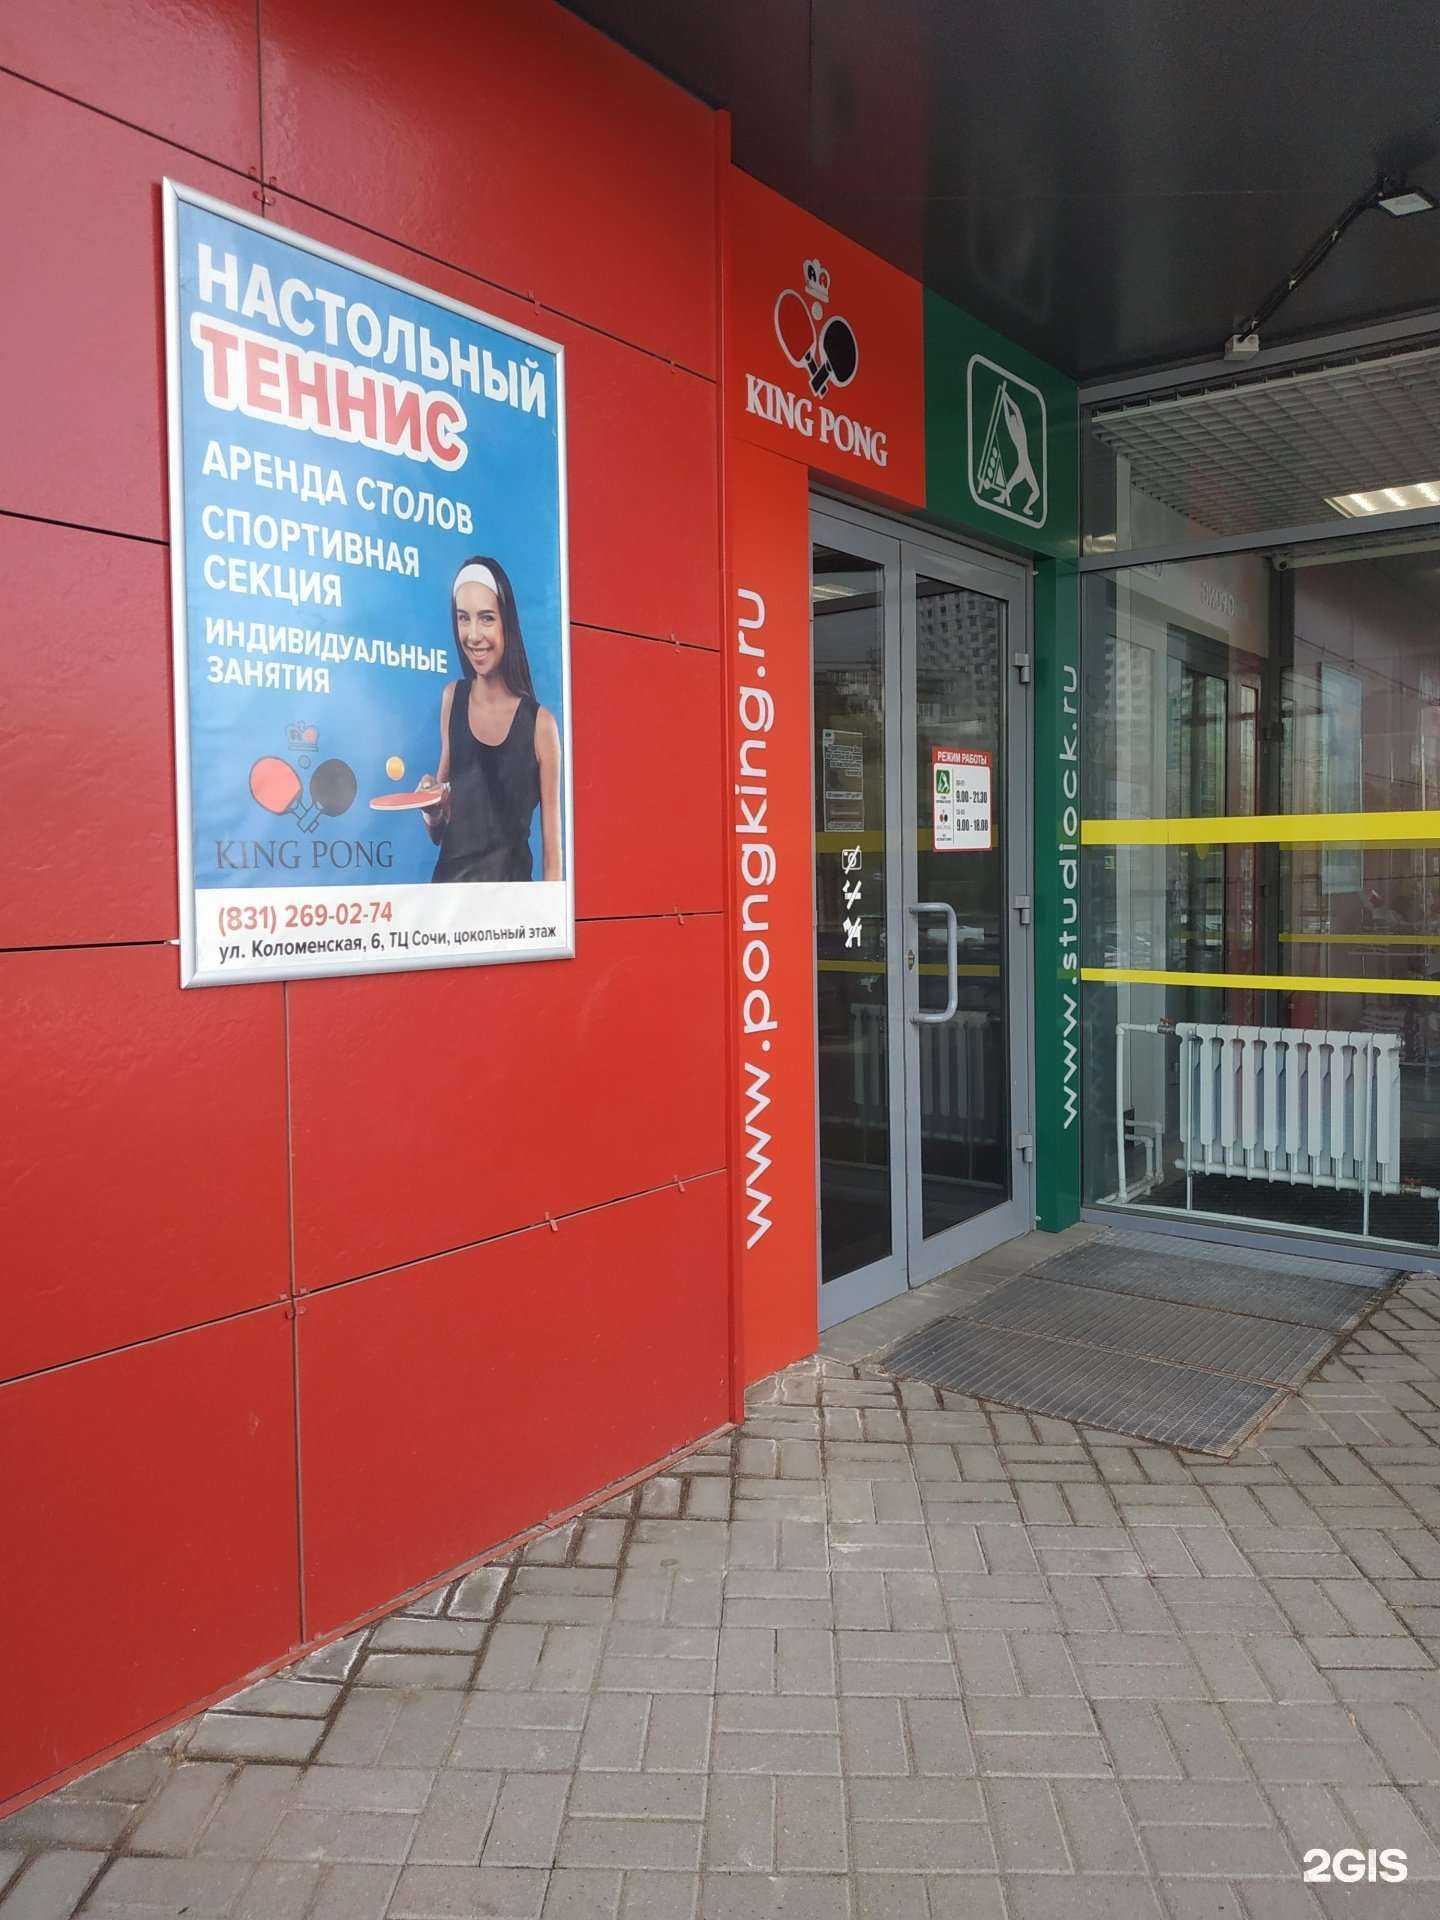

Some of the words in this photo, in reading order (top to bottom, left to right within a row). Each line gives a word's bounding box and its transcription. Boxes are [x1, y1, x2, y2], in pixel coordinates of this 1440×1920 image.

[197, 242, 547, 418] НАСТОЛЬНЫЙ
[196, 319, 464, 467] ТЕННИС
[745, 373, 814, 438] KING
[819, 406, 889, 468] PONG
[202, 440, 348, 506] АРЕНДА
[356, 476, 474, 535] СТОЛОВ
[202, 504, 420, 578] СПОРТИВНАЯ
[203, 554, 343, 608] СЕКЦИЯ
[205, 616, 449, 674] ИНДИВИДУАЛЬНЫЕ
[206, 655, 332, 694] ЗАНЯТИЯ
[937, 751, 961, 763] РЕЖИМ
[961, 753, 987, 765] РАБОТЫ
[215, 840, 301, 869] KING
[311, 840, 394, 868] PONG
[218, 906, 277, 936] (831)
[285, 901, 393, 928] 269-02-74
[735, 588, 778, 1249] www.pongking.ru
[1058, 664, 1078, 1129] www.studiock.ru
[219, 944, 246, 965] ул.
[252, 937, 367, 958] Коломенская,
[371, 932, 385, 951] 6,
[389, 931, 409, 949] ТЦ
[412, 930, 451, 946] Сочи,
[454, 925, 526, 945] цокольный
[529, 925, 557, 939] этаж
